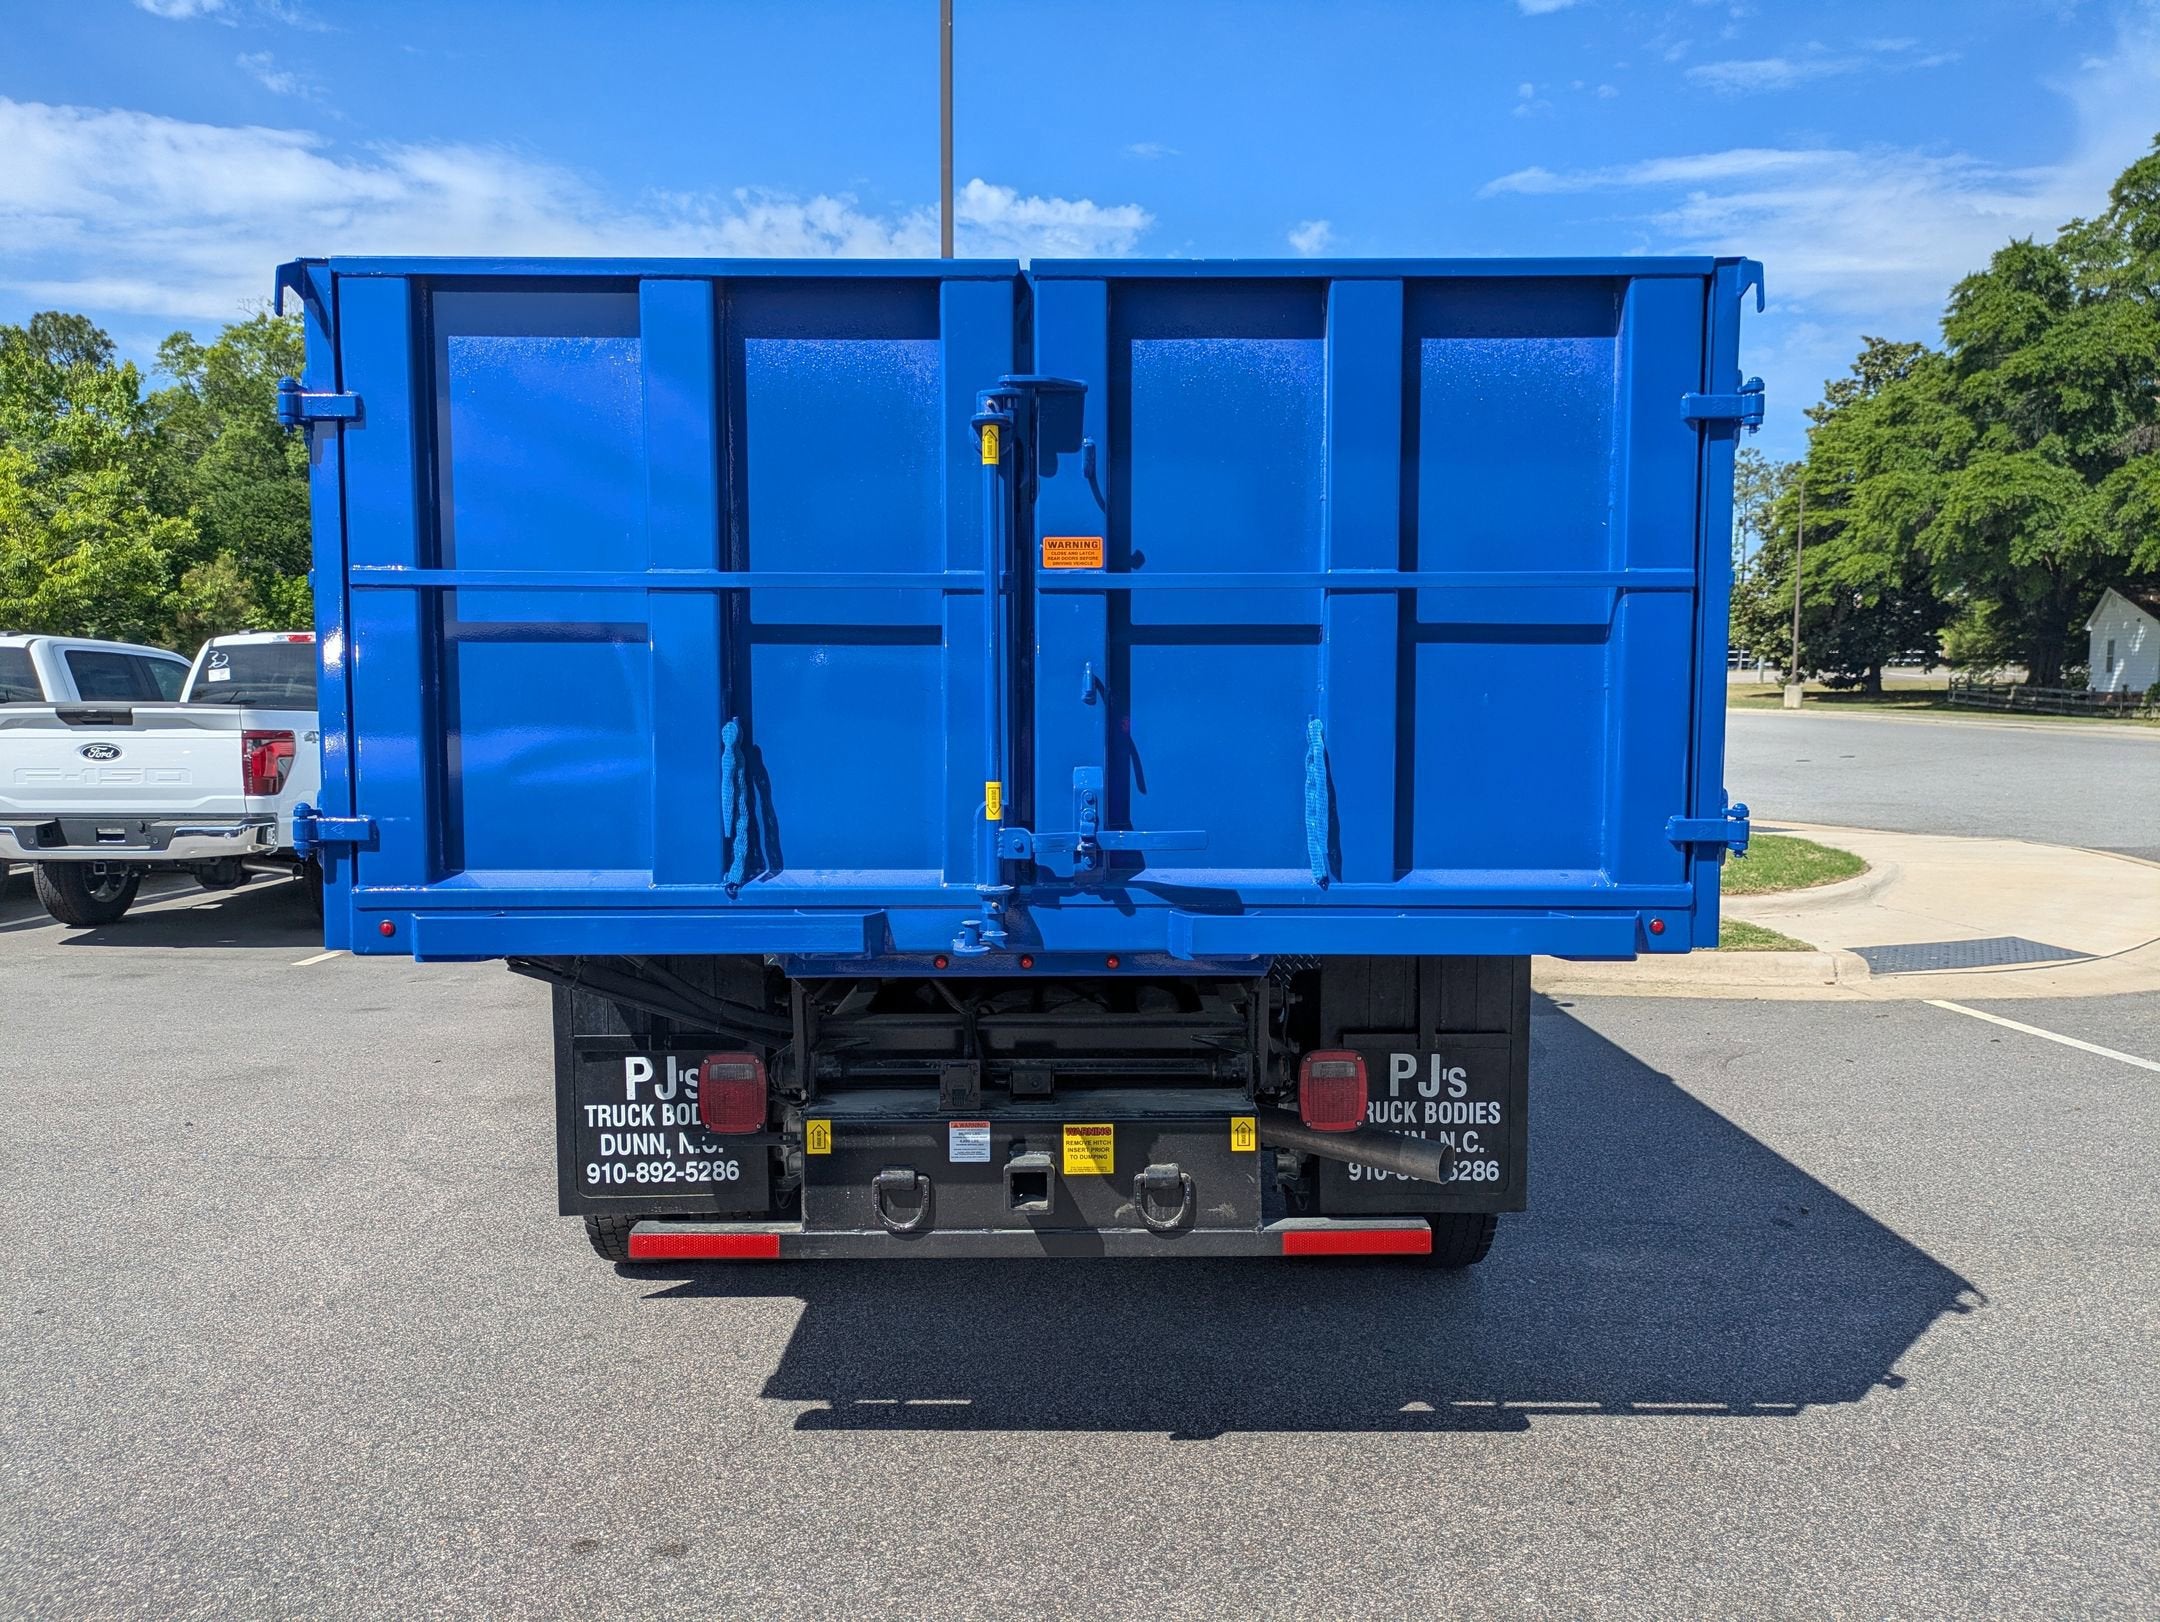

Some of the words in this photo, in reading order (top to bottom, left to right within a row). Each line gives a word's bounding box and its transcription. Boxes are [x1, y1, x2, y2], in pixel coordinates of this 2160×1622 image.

[1047, 541, 1098, 549] WARNING
[87, 747, 115, 758] Ford
[13, 767, 193, 785] F-150
[584, 1103, 655, 1128] TRUCK
[662, 1102, 702, 1127] BOD
[1367, 1100, 1417, 1124] RUCK
[1424, 1101, 1501, 1125] BODIES
[1065, 1126, 1112, 1136] WARNING
[600, 1133, 671, 1159] DUNN,
[586, 1160, 740, 1185] 910-892-5286
[1348, 1160, 1500, 1182] 910-5286
